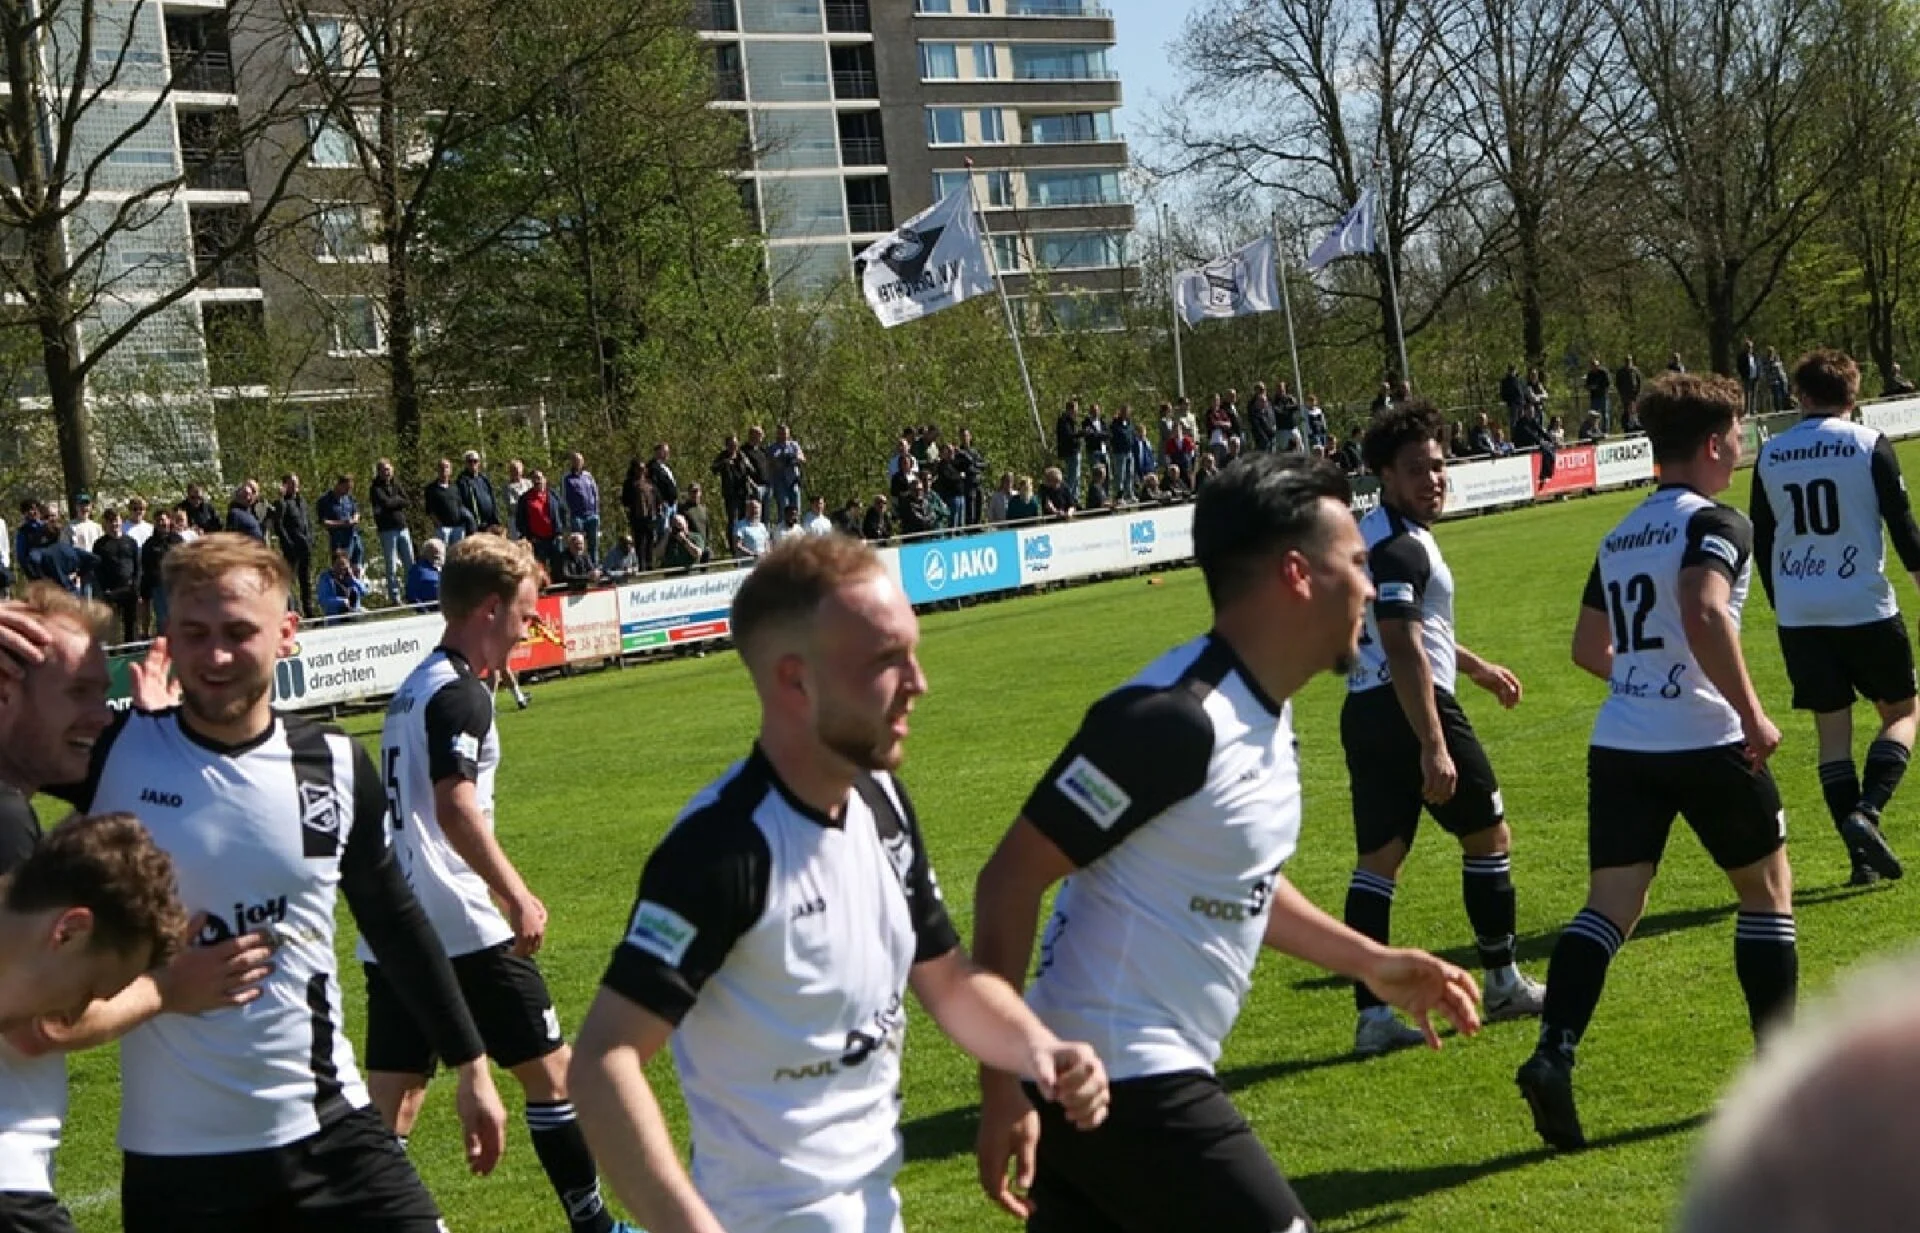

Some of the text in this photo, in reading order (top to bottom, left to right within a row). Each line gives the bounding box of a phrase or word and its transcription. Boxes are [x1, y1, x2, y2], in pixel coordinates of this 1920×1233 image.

[1783, 478, 1840, 535] 10
[952, 547, 998, 580] JAKO
[1837, 544, 1859, 579] 8
[1608, 573, 1664, 654] 12
[307, 637, 419, 669] van der meulen
[310, 665, 376, 690] drachten
[1661, 663, 1687, 699] 8
[141, 788, 183, 808] JAKO
[234, 896, 288, 935] joy
